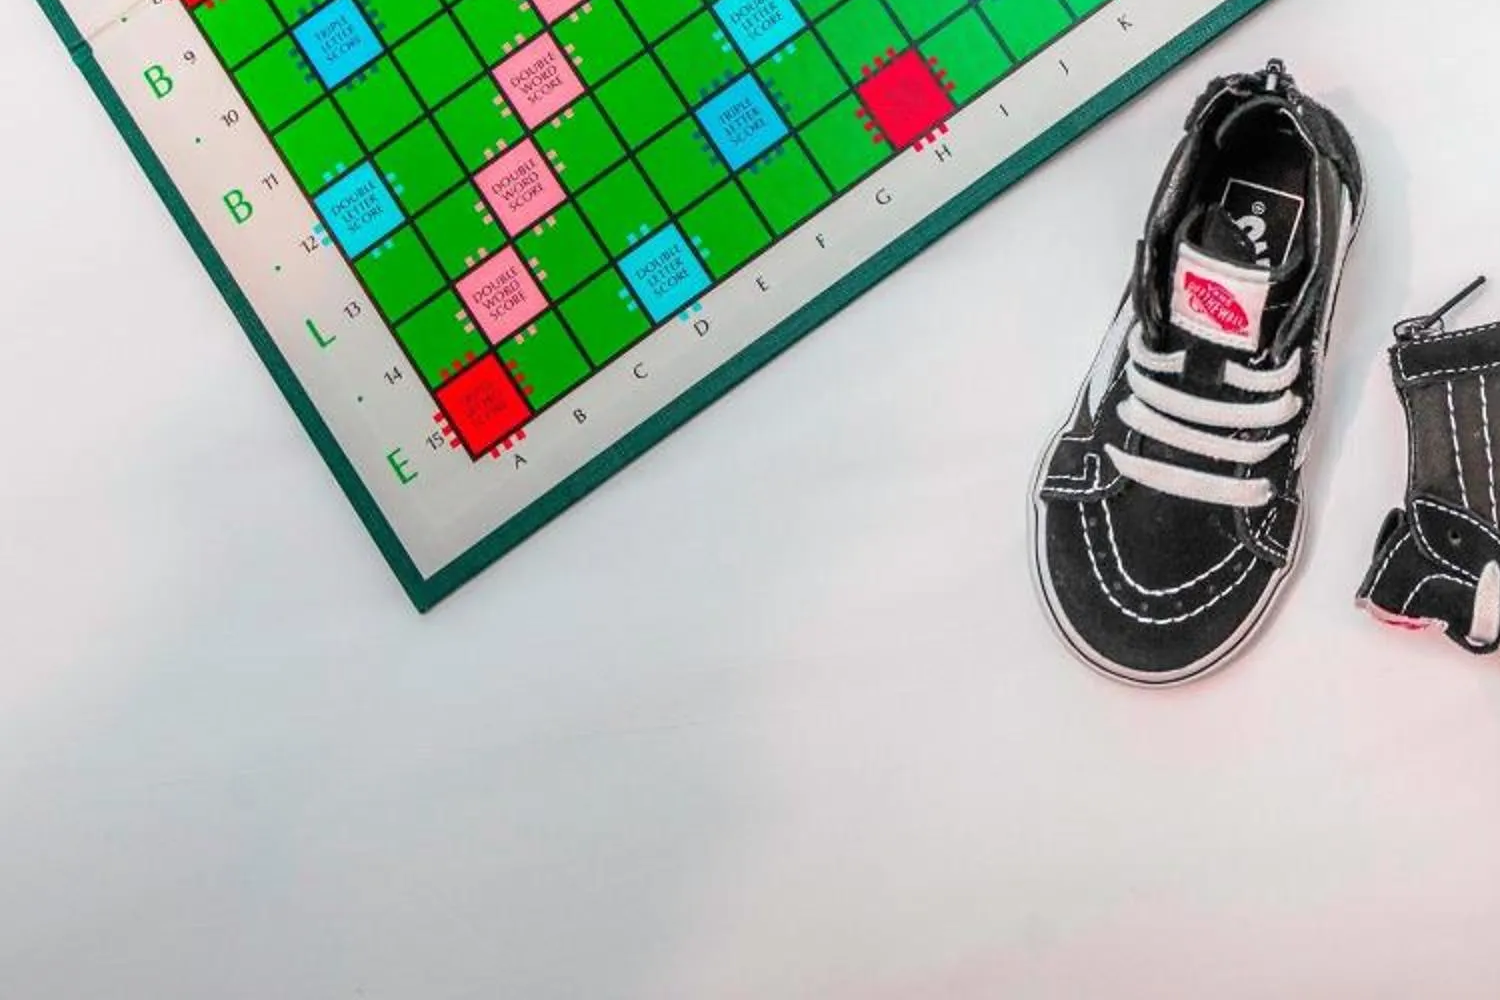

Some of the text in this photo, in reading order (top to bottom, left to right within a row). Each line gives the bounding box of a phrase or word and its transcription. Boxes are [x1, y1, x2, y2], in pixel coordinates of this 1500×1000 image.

[141, 63, 174, 100] B
[221, 187, 254, 225] B
[304, 317, 337, 350] L
[385, 446, 419, 485] E
[181, 49, 197, 65] 9
[219, 108, 240, 128] 10
[260, 171, 279, 191] 11
[298, 234, 319, 254] 12
[342, 300, 362, 320] 13
[382, 364, 403, 385] 14
[424, 430, 445, 451] 15
[512, 452, 528, 470] A
[571, 406, 588, 425] B
[632, 360, 649, 380] C
[692, 318, 710, 338] D
[754, 274, 770, 293] E
[814, 232, 825, 249] F
[874, 186, 893, 205] G
[932, 142, 953, 163] H
[1115, 12, 1134, 32] K
